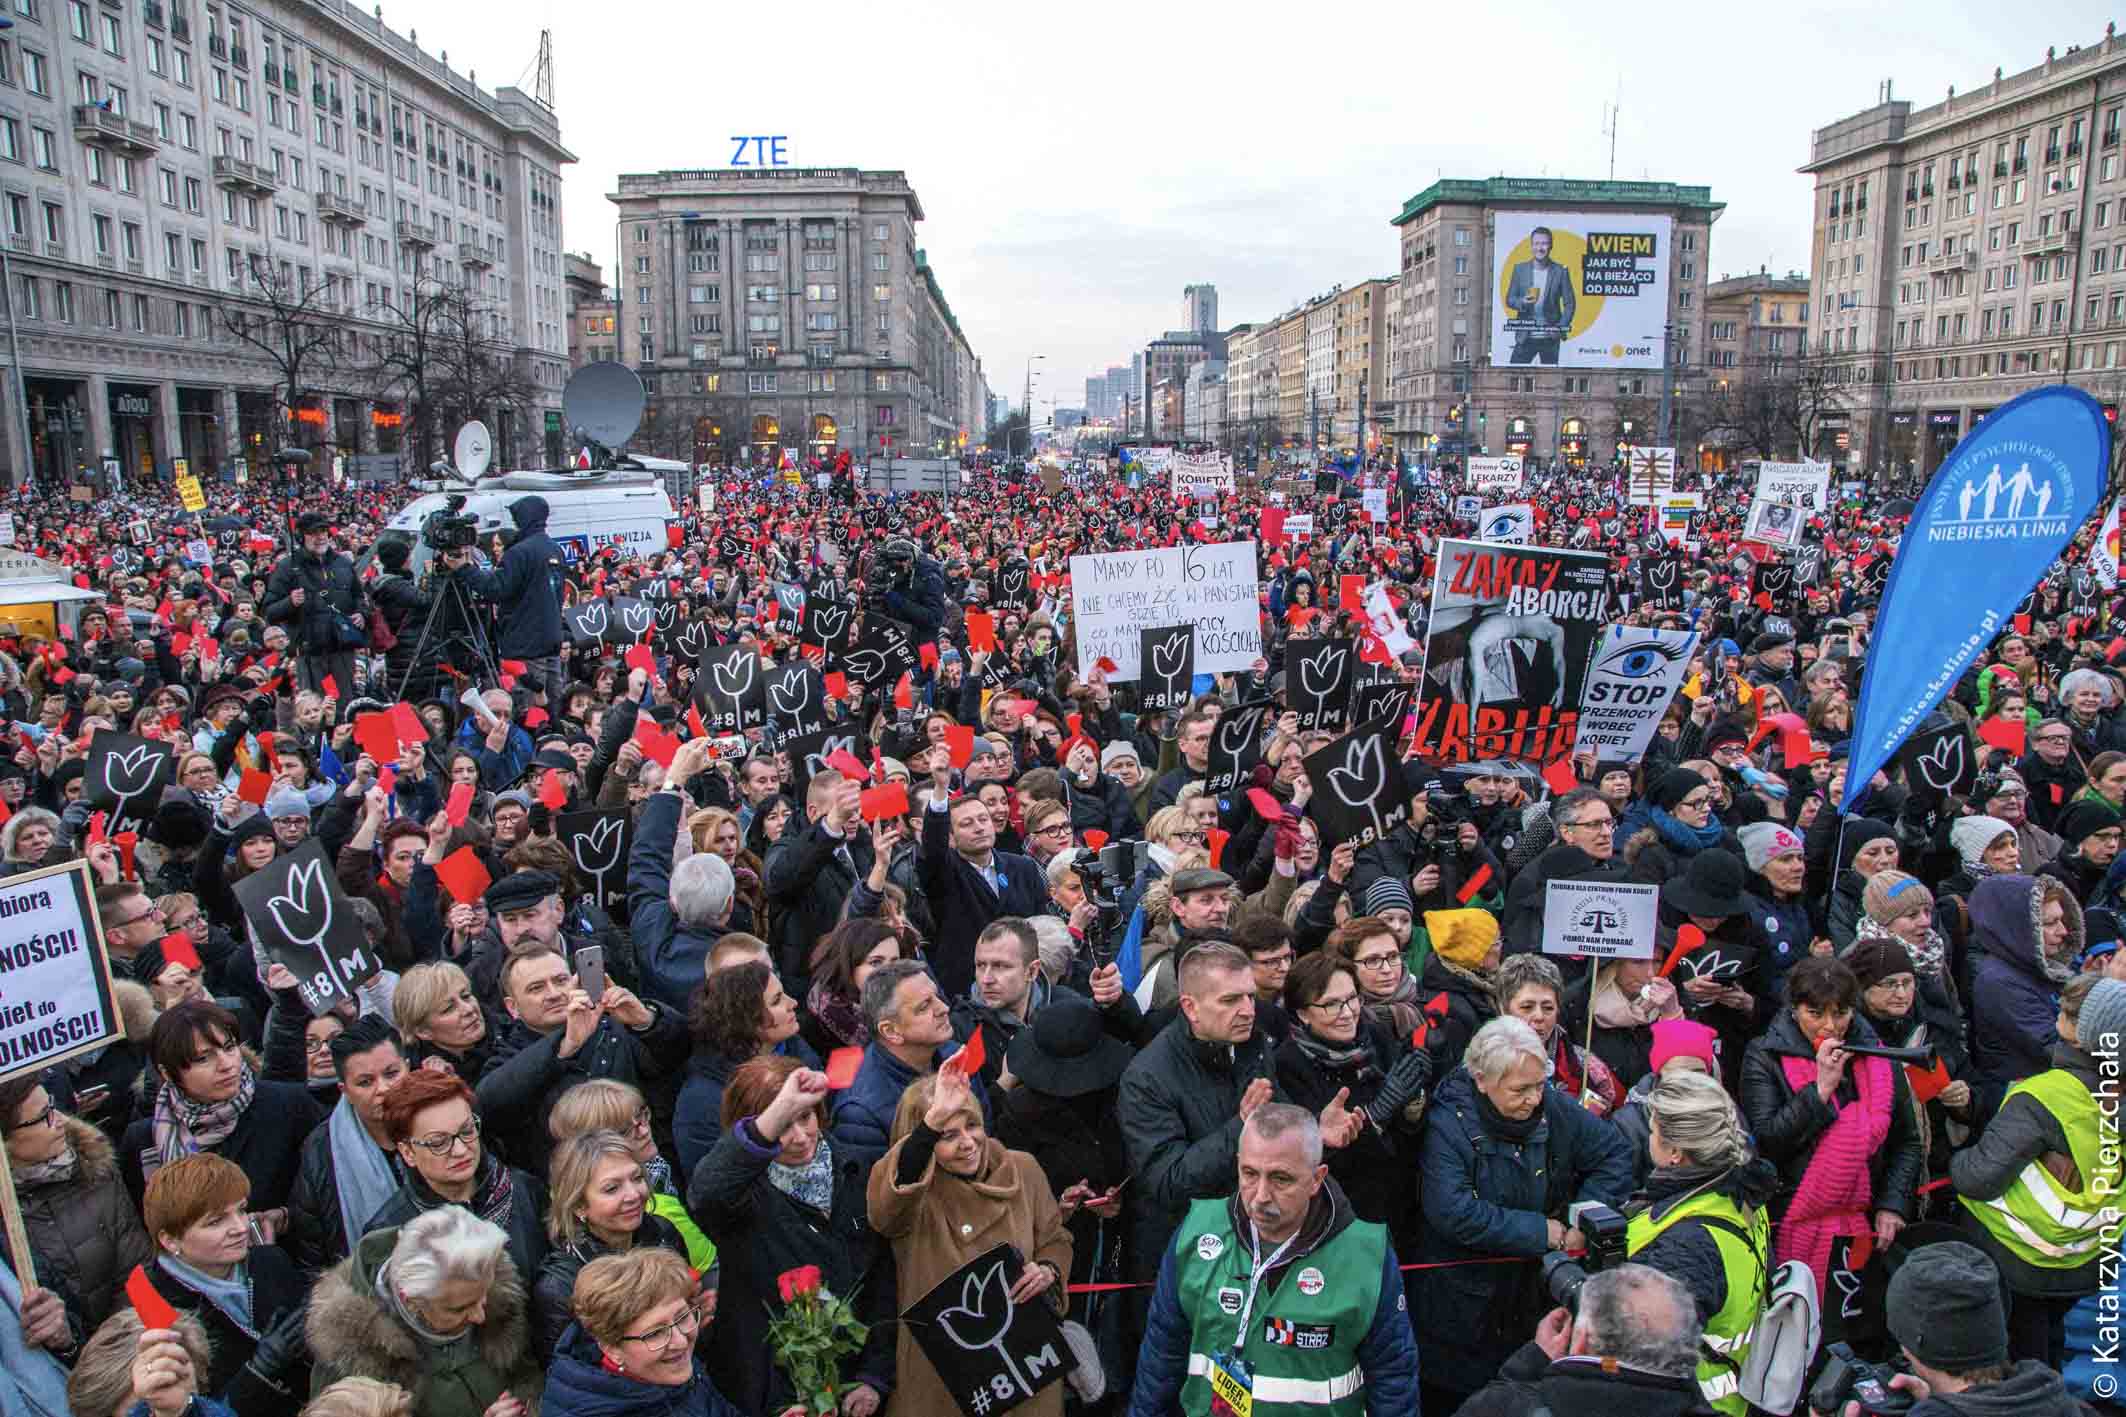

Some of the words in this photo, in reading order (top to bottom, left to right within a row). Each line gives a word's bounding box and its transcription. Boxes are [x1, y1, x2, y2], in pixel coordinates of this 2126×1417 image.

[730, 136, 788, 165] ZTE
[1590, 235, 1652, 254] WIEM
[1586, 258, 1607, 268] JAK
[1610, 256, 1631, 268] BYĆ
[1586, 271, 1602, 280] NA
[1605, 269, 1652, 284] BIEŻĄCO
[1585, 284, 1602, 293] OD
[1604, 285, 1635, 294] RANA
[1625, 345, 1651, 356] onet
[1928, 522, 2017, 543] NIEBIESKA
[2022, 519, 2067, 538] LINIA
[0, 560, 40, 569] ERIA
[1093, 557, 1136, 583] MAMY
[1145, 557, 1164, 578] PO
[1182, 544, 1206, 583] 16
[1212, 560, 1233, 579] LAT
[1450, 551, 1562, 599] ZAKAZ
[1082, 594, 1103, 612] NIE
[1108, 590, 1147, 608] CHCEMY
[1186, 588, 1198, 602] W
[1588, 682, 1667, 705] STOP
[1583, 706, 1657, 720] PRZEMOCY
[1410, 697, 1577, 765] ZABIJA
[1586, 721, 1636, 732] WOBEC
[1579, 734, 1631, 746] KOBIET
[38, 1001, 56, 1017] do
[1216, 1372, 1244, 1400] LIDER
